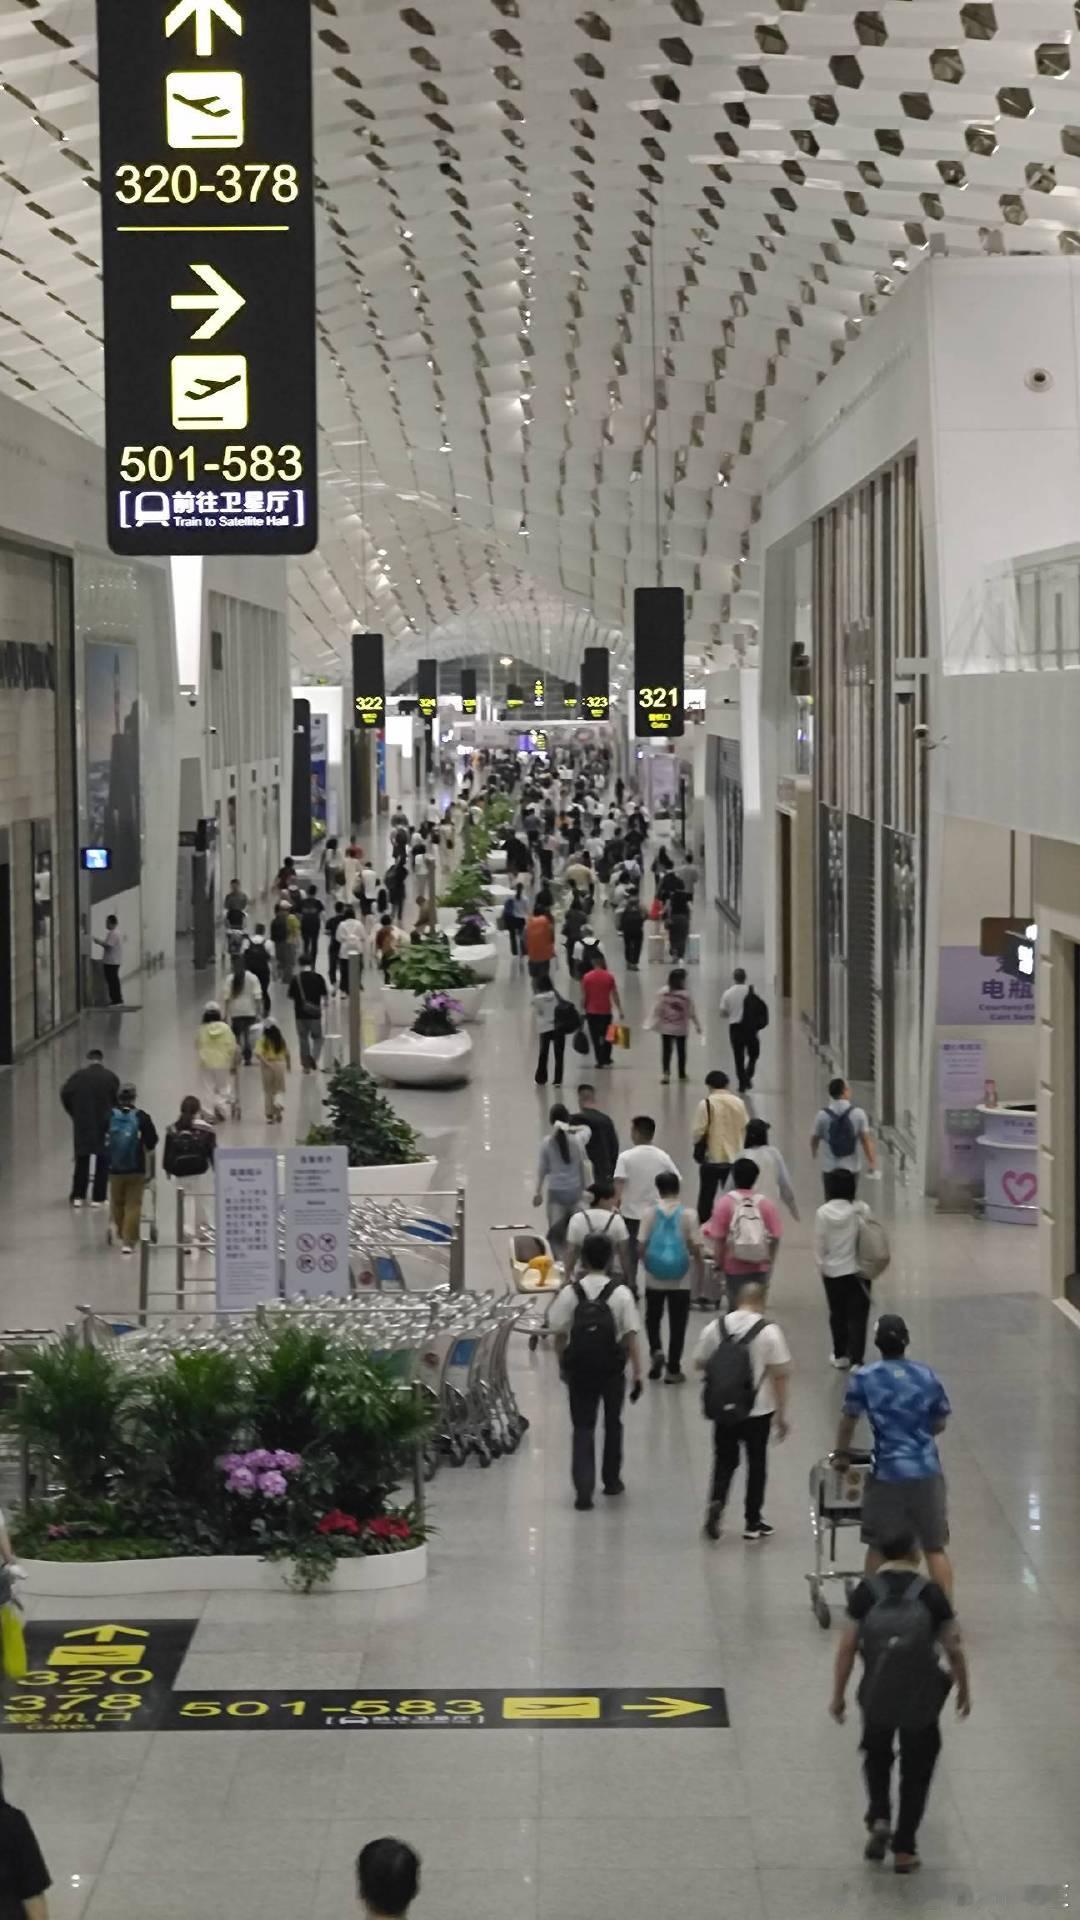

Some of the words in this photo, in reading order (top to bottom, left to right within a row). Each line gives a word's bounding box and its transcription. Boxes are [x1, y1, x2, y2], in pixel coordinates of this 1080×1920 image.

[115, 164, 299, 204] 320-378
[119, 445, 303, 482] 501-583
[172, 490, 290, 513] 前往卫星厅
[172, 516, 202, 527] Train
[204, 516, 216, 527] to
[218, 516, 264, 527] Satellite
[266, 516, 289, 527] Hall
[355, 696, 383, 710] 322
[586, 696, 609, 707] 323
[639, 687, 678, 708] 321
[16, 1669, 154, 1686] 320
[3, 1693, 143, 1711] 378
[179, 1700, 485, 1717] 501-583
